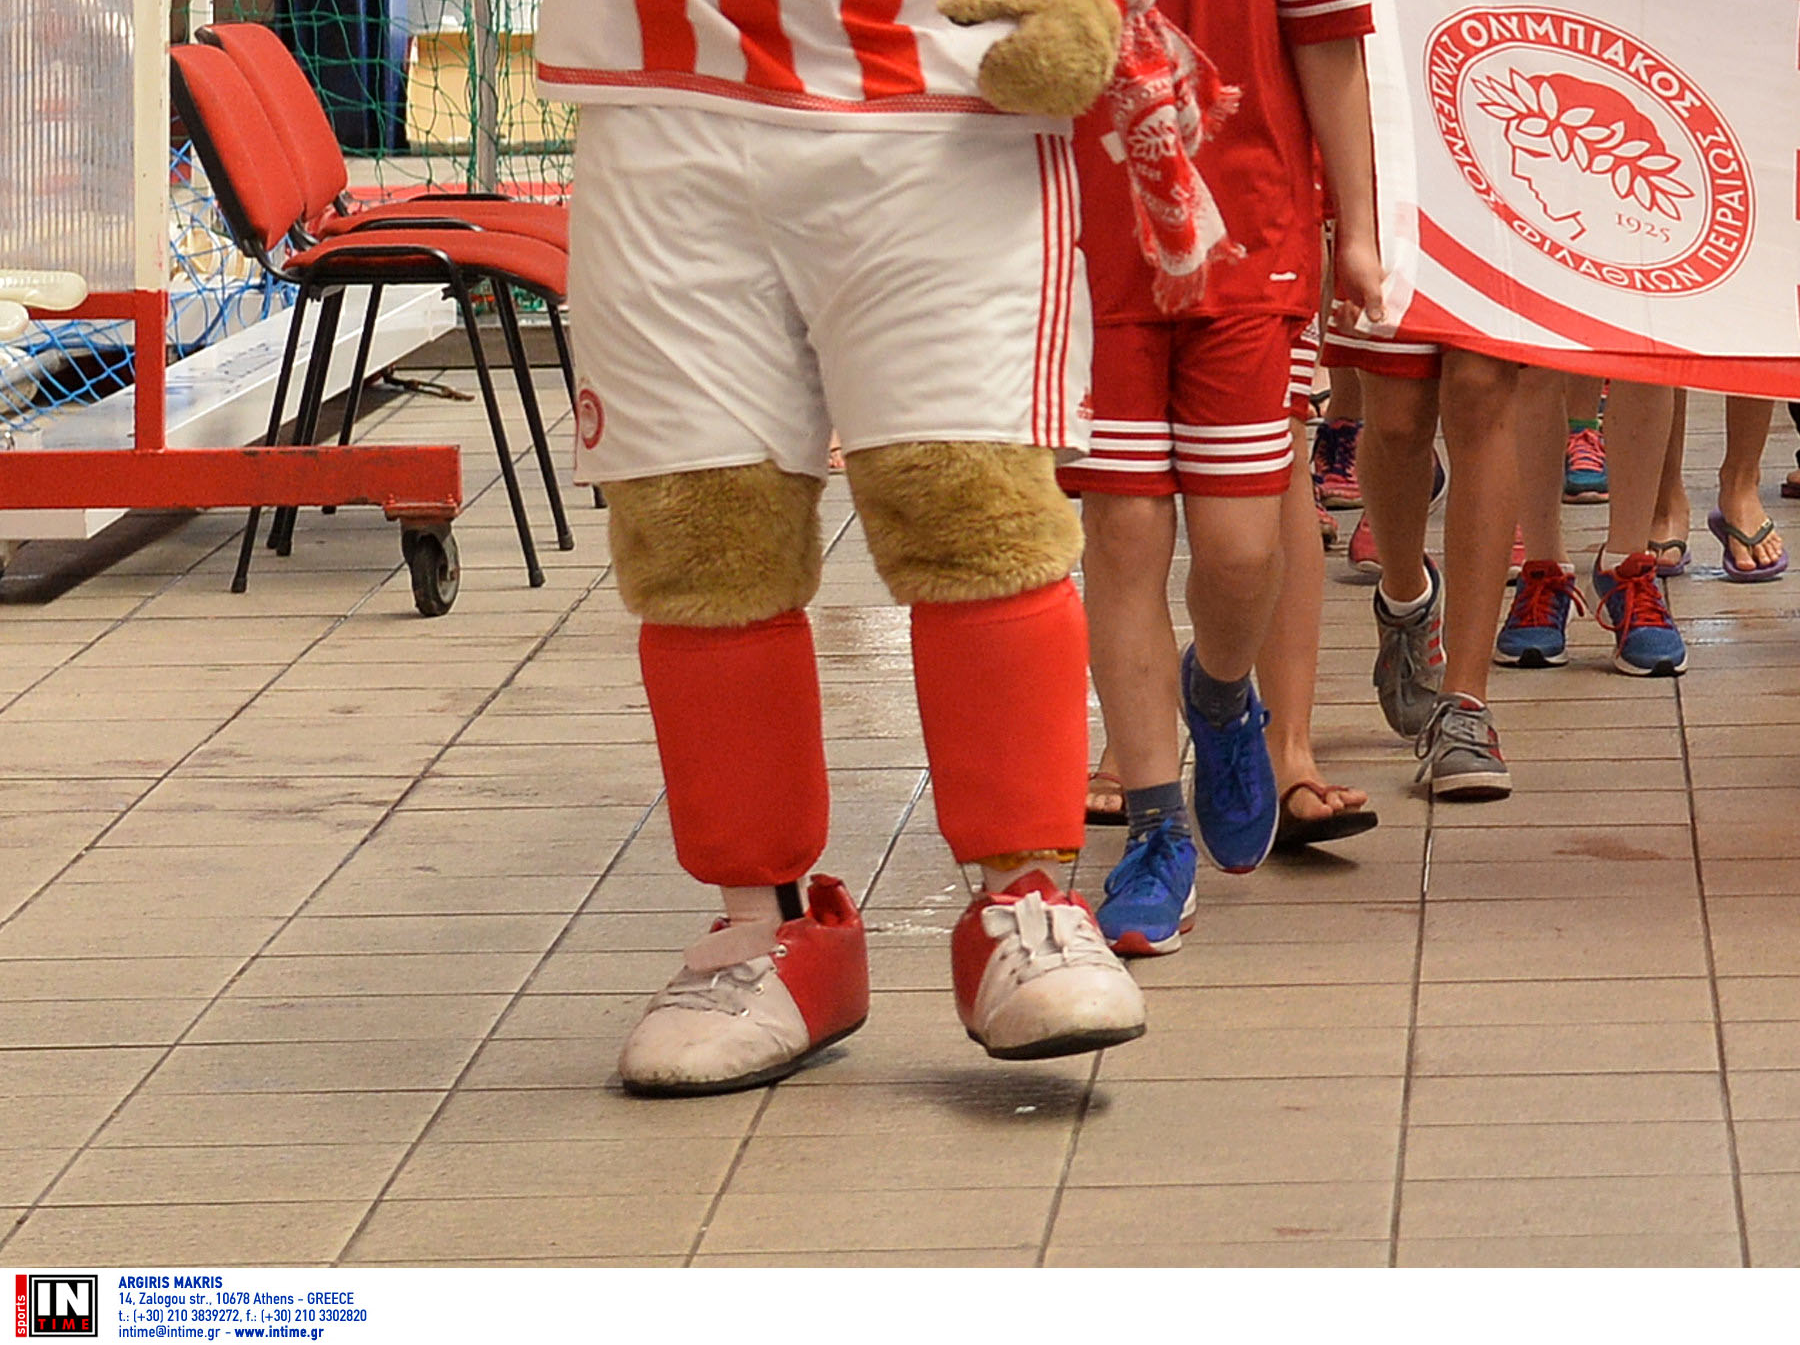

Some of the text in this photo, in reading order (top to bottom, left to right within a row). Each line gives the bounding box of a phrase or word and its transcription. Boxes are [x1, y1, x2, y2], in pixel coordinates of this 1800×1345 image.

[1461, 13, 1701, 119] ΟΛΥΜΠΙΑΚΟΣ
[1430, 36, 1747, 292] ΣΥΝΔΕΣΜΟΣ ΦΙΛΑΘΛΩΝ ΠΕΙΡΑΙΩΣ
[1615, 212, 1671, 244] 1925
